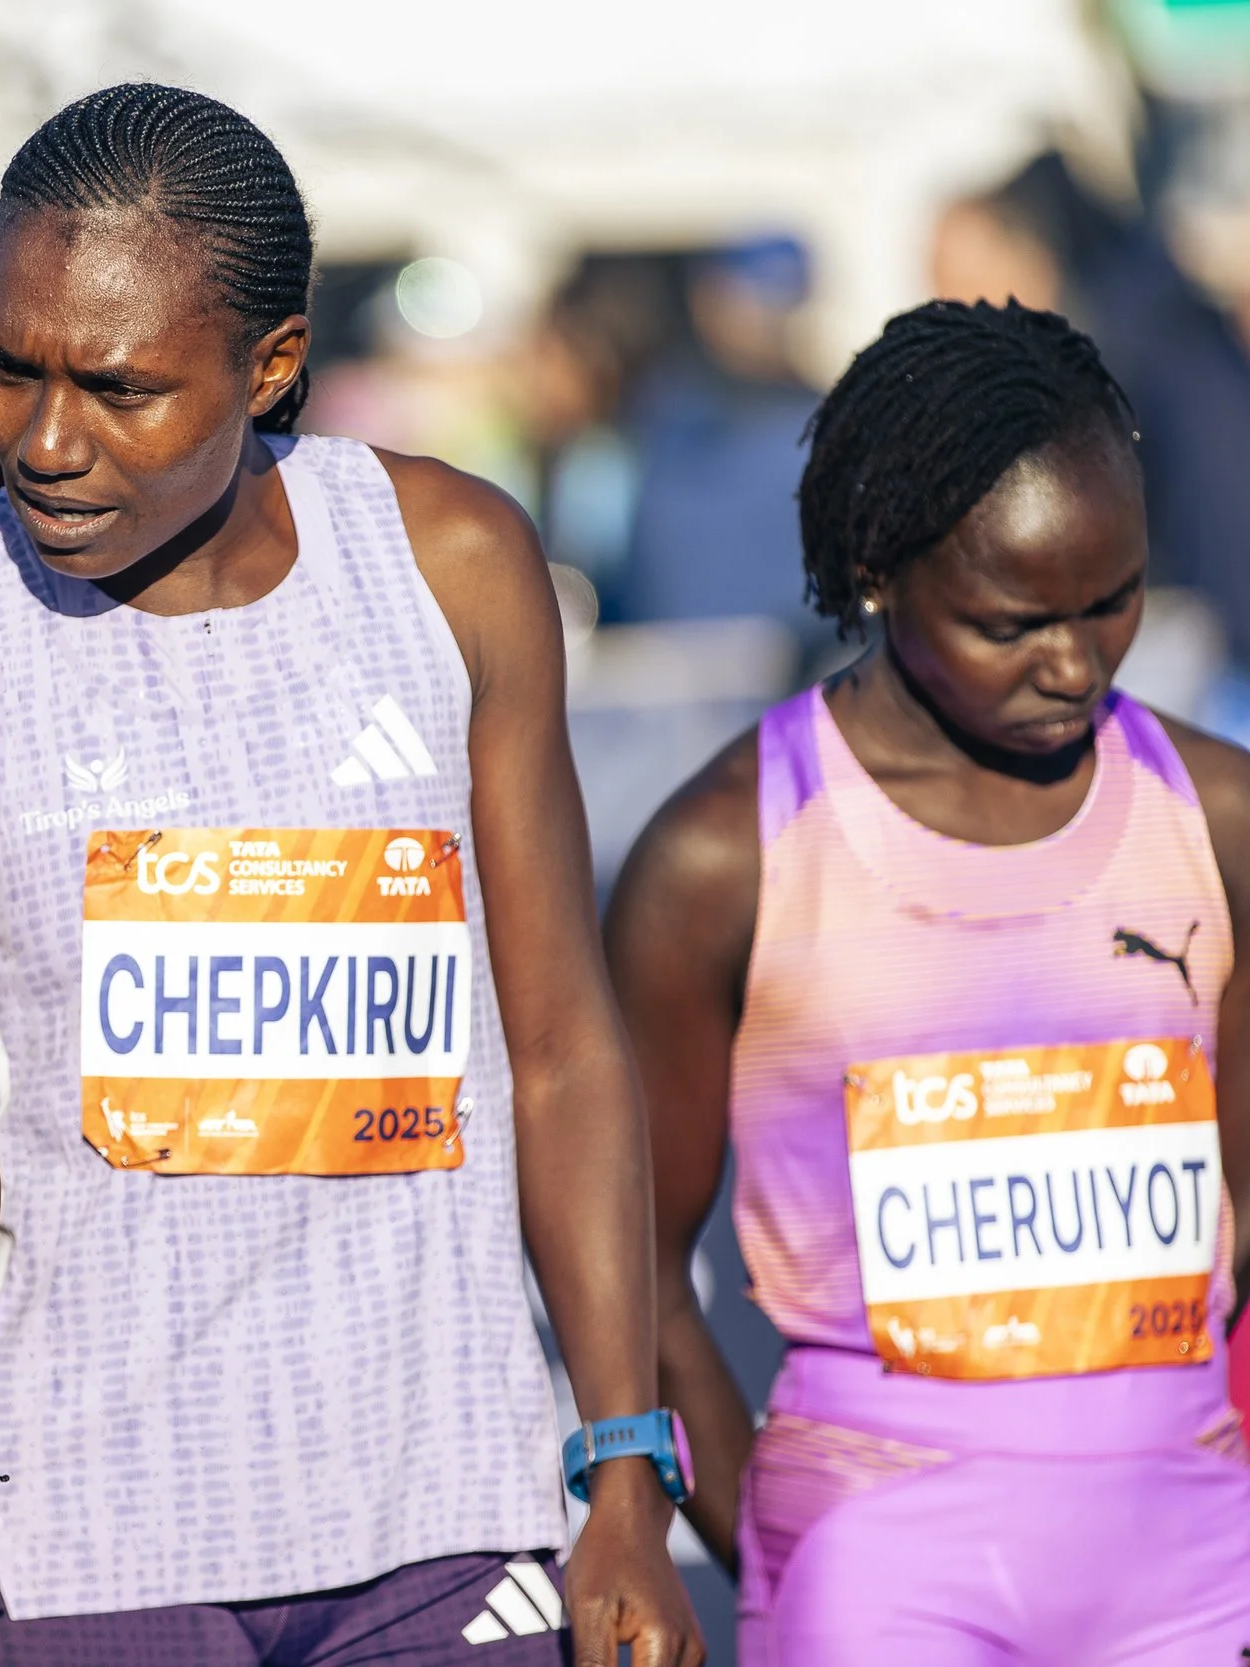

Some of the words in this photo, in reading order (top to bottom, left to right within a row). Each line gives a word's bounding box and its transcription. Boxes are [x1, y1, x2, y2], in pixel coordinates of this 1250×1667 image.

[19, 800, 101, 835] Tirop's
[106, 787, 190, 819] Angels
[137, 846, 220, 895] tcs
[229, 841, 280, 858] TATA
[229, 860, 348, 877] CONSULTANCY
[229, 879, 305, 895] SERVICES
[377, 876, 431, 896] TATA
[99, 953, 456, 1056] CHEPKIRUI
[892, 1069, 978, 1125] tcs
[353, 1107, 445, 1143] 2025
[877, 1159, 1207, 1269] CHERUIYOT
